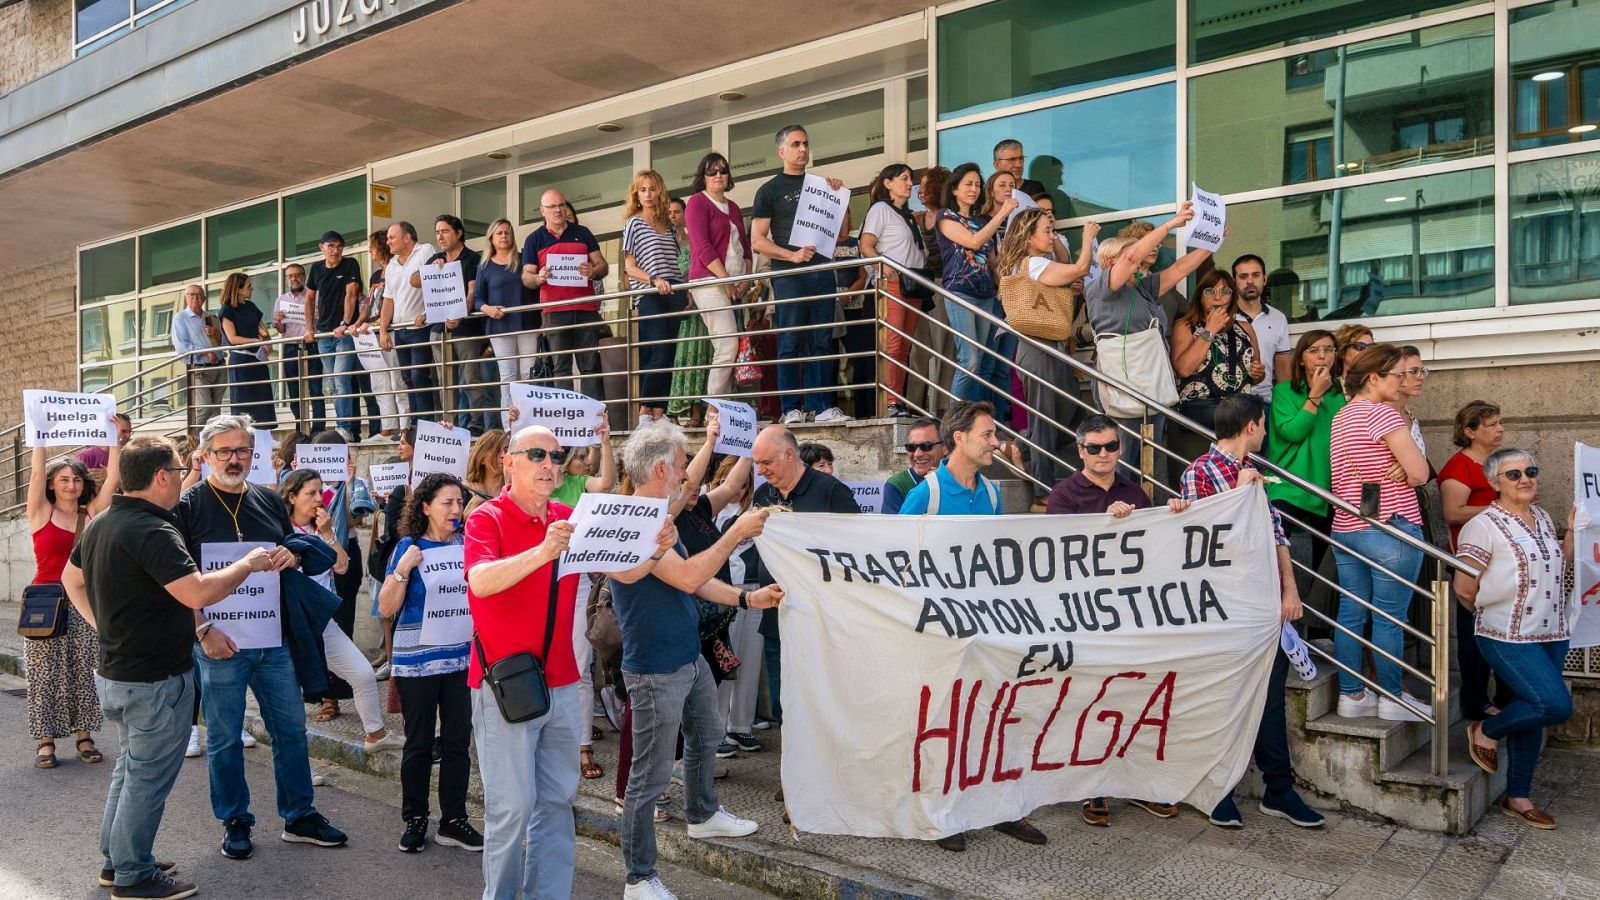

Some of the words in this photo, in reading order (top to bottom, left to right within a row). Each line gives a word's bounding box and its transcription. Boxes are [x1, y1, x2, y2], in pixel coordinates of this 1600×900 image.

[804, 186, 841, 206] JUSTICIA
[808, 204, 835, 220] Huelga
[1203, 211, 1222, 226] Huelga
[796, 219, 836, 239] INDEFINIDA
[1191, 228, 1221, 244] Indefinida
[423, 272, 457, 280] JUSTICIA
[431, 286, 456, 294] Huelga
[427, 298, 464, 307] INDEFINIDA
[40, 396, 101, 405] JUSTICIA
[526, 390, 588, 400] JUSTICIA
[47, 411, 97, 423] Huelga
[532, 407, 585, 420] Huelga
[729, 415, 753, 431] Huelga
[36, 428, 107, 440] Indefinida
[550, 426, 594, 438] finida
[418, 434, 462, 447] JUSTICIA
[721, 434, 753, 450] Indefinida
[424, 452, 456, 465] Huelga
[373, 473, 407, 482] CLASISMO
[851, 487, 880, 496] STICIA
[591, 503, 659, 518] JUSTICIA
[859, 503, 874, 514] lga
[584, 526, 641, 542] Huelga
[563, 549, 640, 564] Indefinida
[806, 529, 1146, 589] TRABAJADORES
[1182, 523, 1233, 571] DE
[423, 561, 464, 573] JUSTIC
[230, 585, 265, 597] elga
[438, 584, 467, 594] Huelg
[208, 610, 276, 620] INDEFINIDA
[427, 607, 471, 618] INDEFINI
[1017, 640, 1073, 678] EN
[912, 671, 1177, 795] HUELGA
